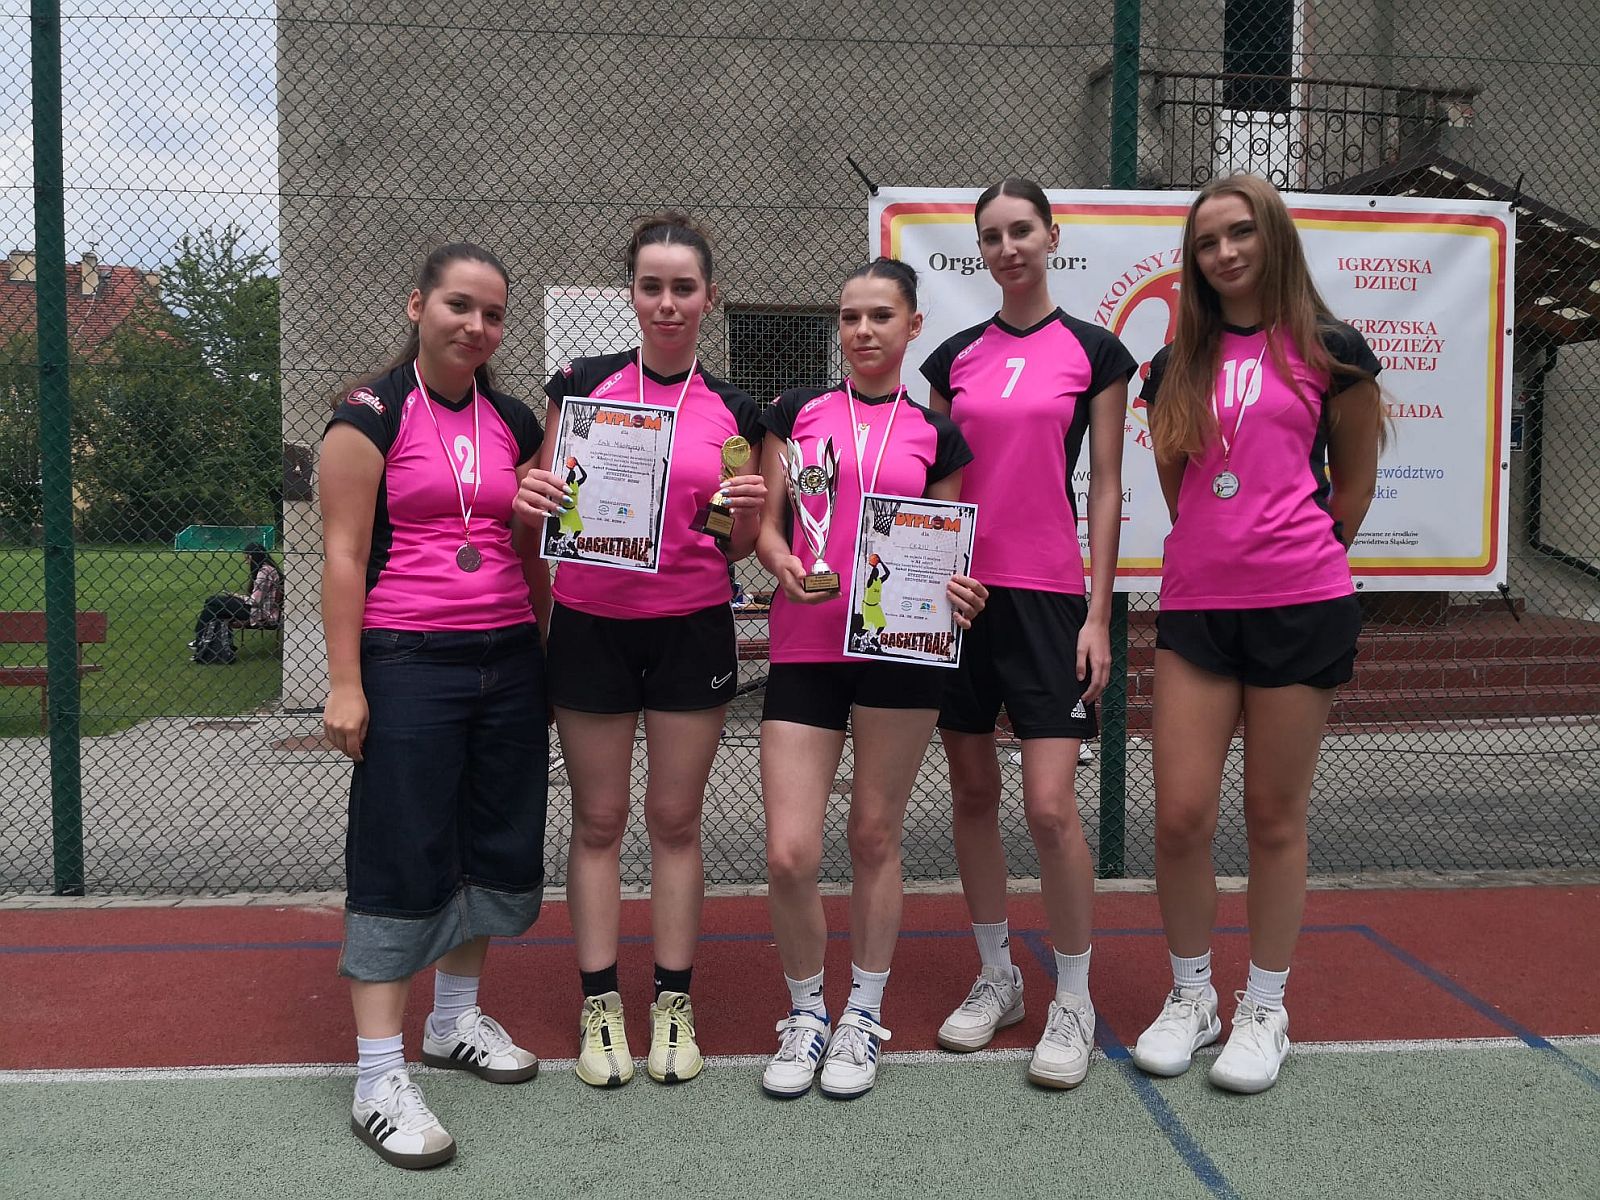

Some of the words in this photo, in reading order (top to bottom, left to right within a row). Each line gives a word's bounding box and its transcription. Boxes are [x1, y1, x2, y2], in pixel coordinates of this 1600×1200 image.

[929, 252, 1087, 275] Orgator:
[1337, 257, 1432, 274] IGRZYSKA
[1094, 252, 1164, 326] ZKOLNY
[1355, 275, 1418, 291] DZIECI
[1366, 335, 1445, 353] ODZIEŻY
[1378, 356, 1438, 371] OLNEJ
[1001, 358, 1026, 398] 7
[1223, 358, 1263, 408] 10
[1387, 404, 1444, 418] LIADA
[453, 435, 481, 484] 2
[1377, 465, 1444, 479] ewództwo
[895, 512, 961, 532] DYPLOM
